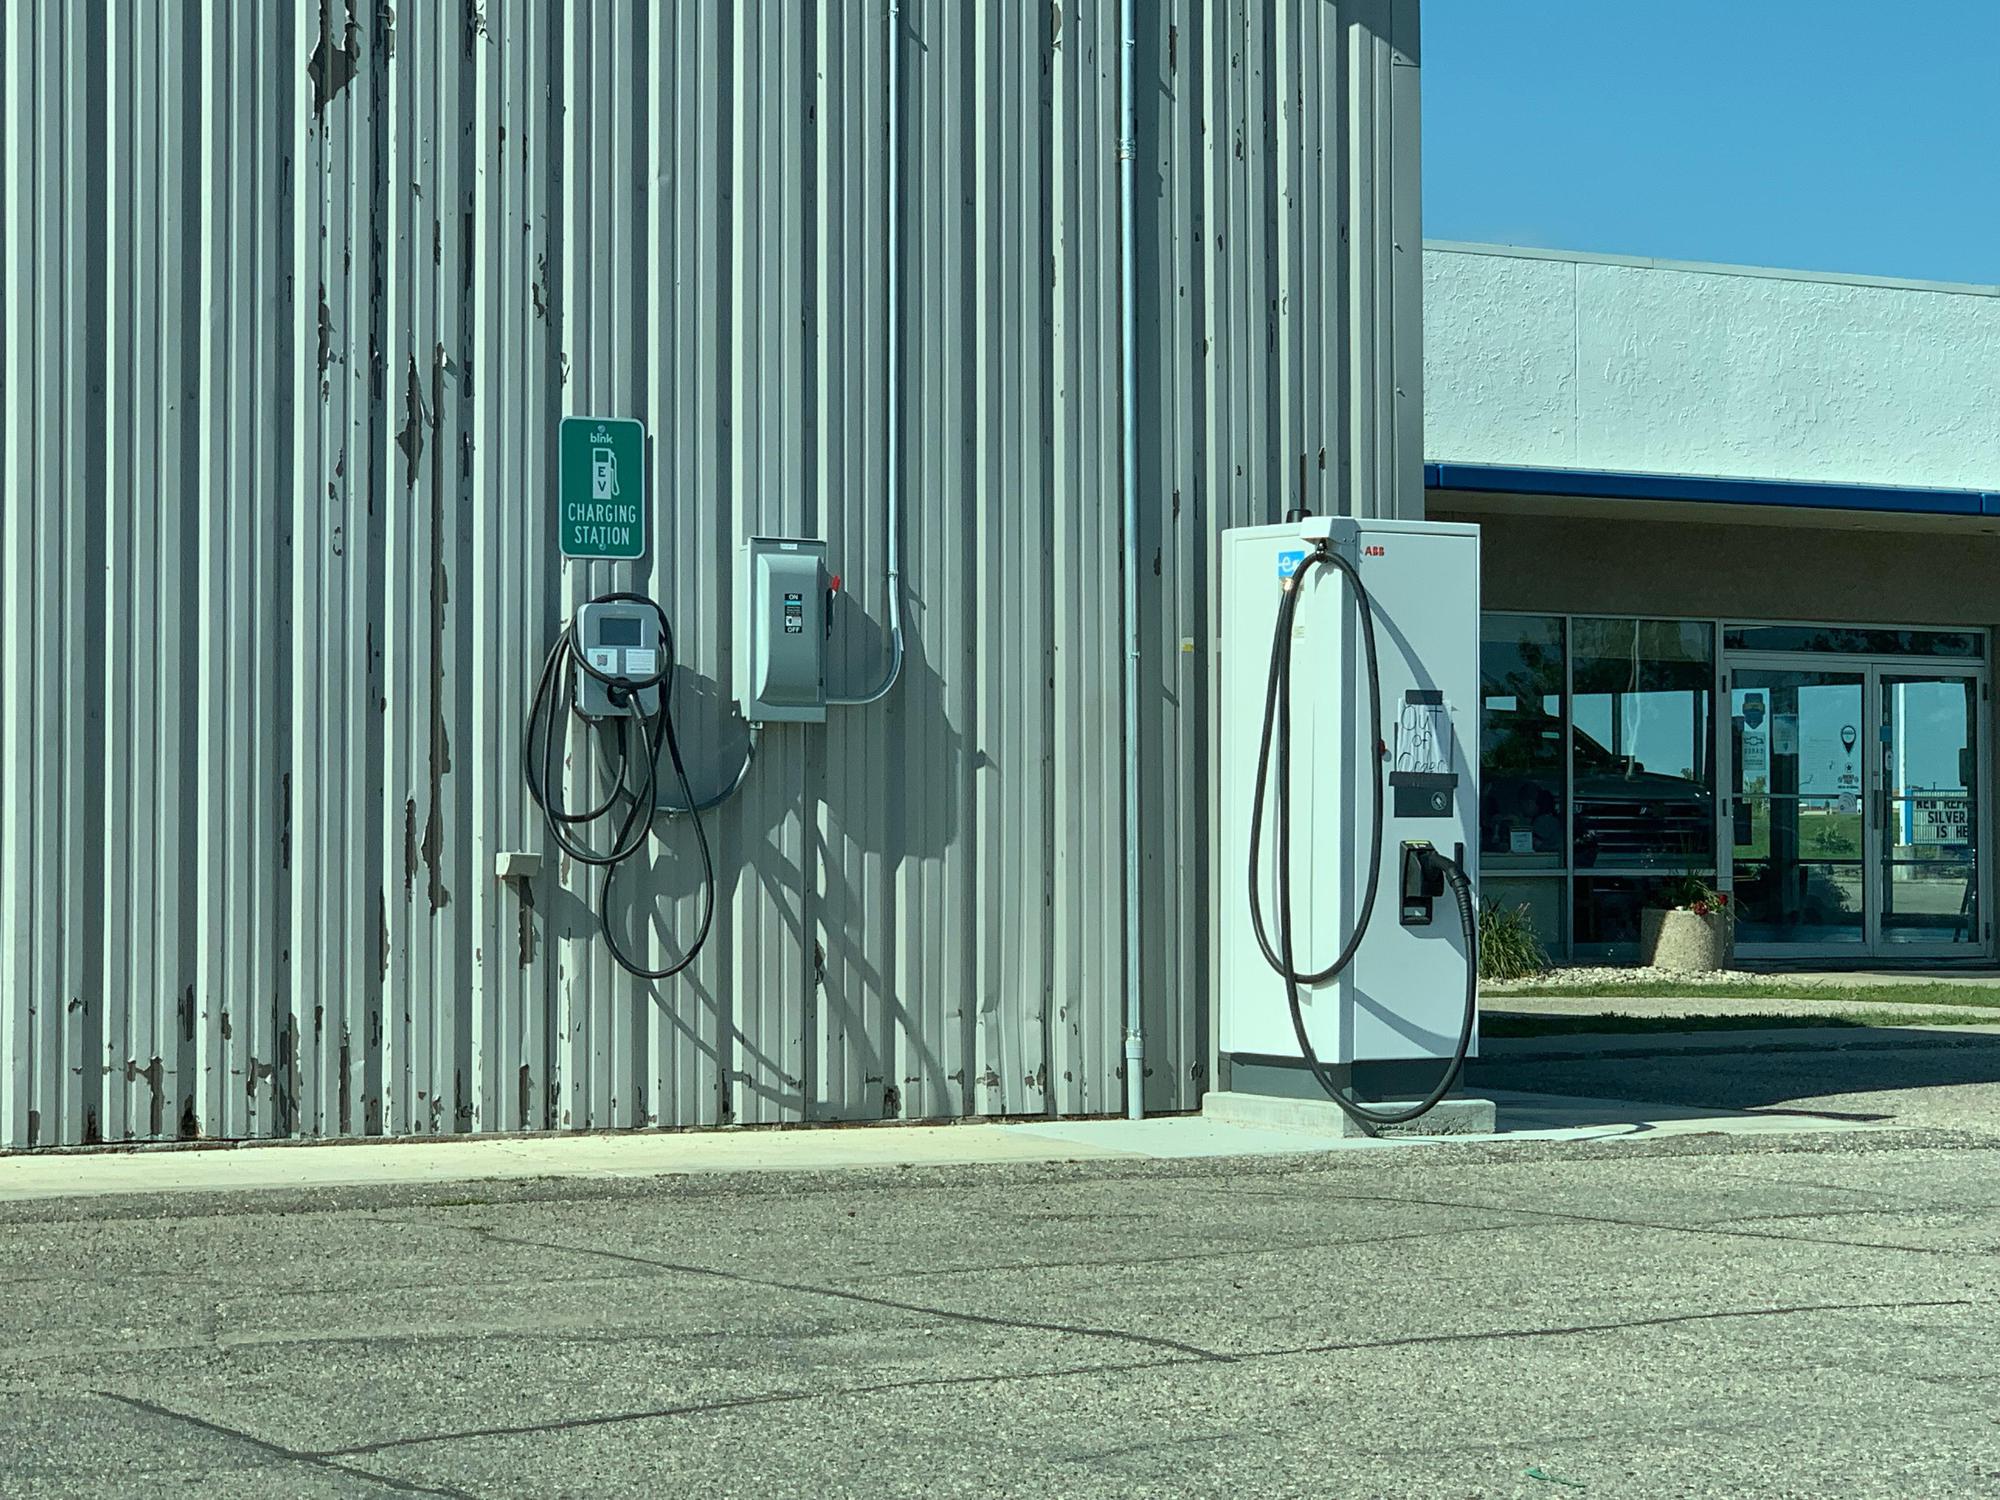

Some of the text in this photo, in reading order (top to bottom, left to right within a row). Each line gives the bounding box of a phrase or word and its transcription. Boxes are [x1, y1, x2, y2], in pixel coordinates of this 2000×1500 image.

[590, 432, 613, 444] blink
[568, 502, 636, 523] CHARGING
[574, 525, 630, 545] STATION
[1364, 546, 1385, 556] ABB
[1412, 731, 1432, 750] of
[1936, 826, 1947, 839] IS
